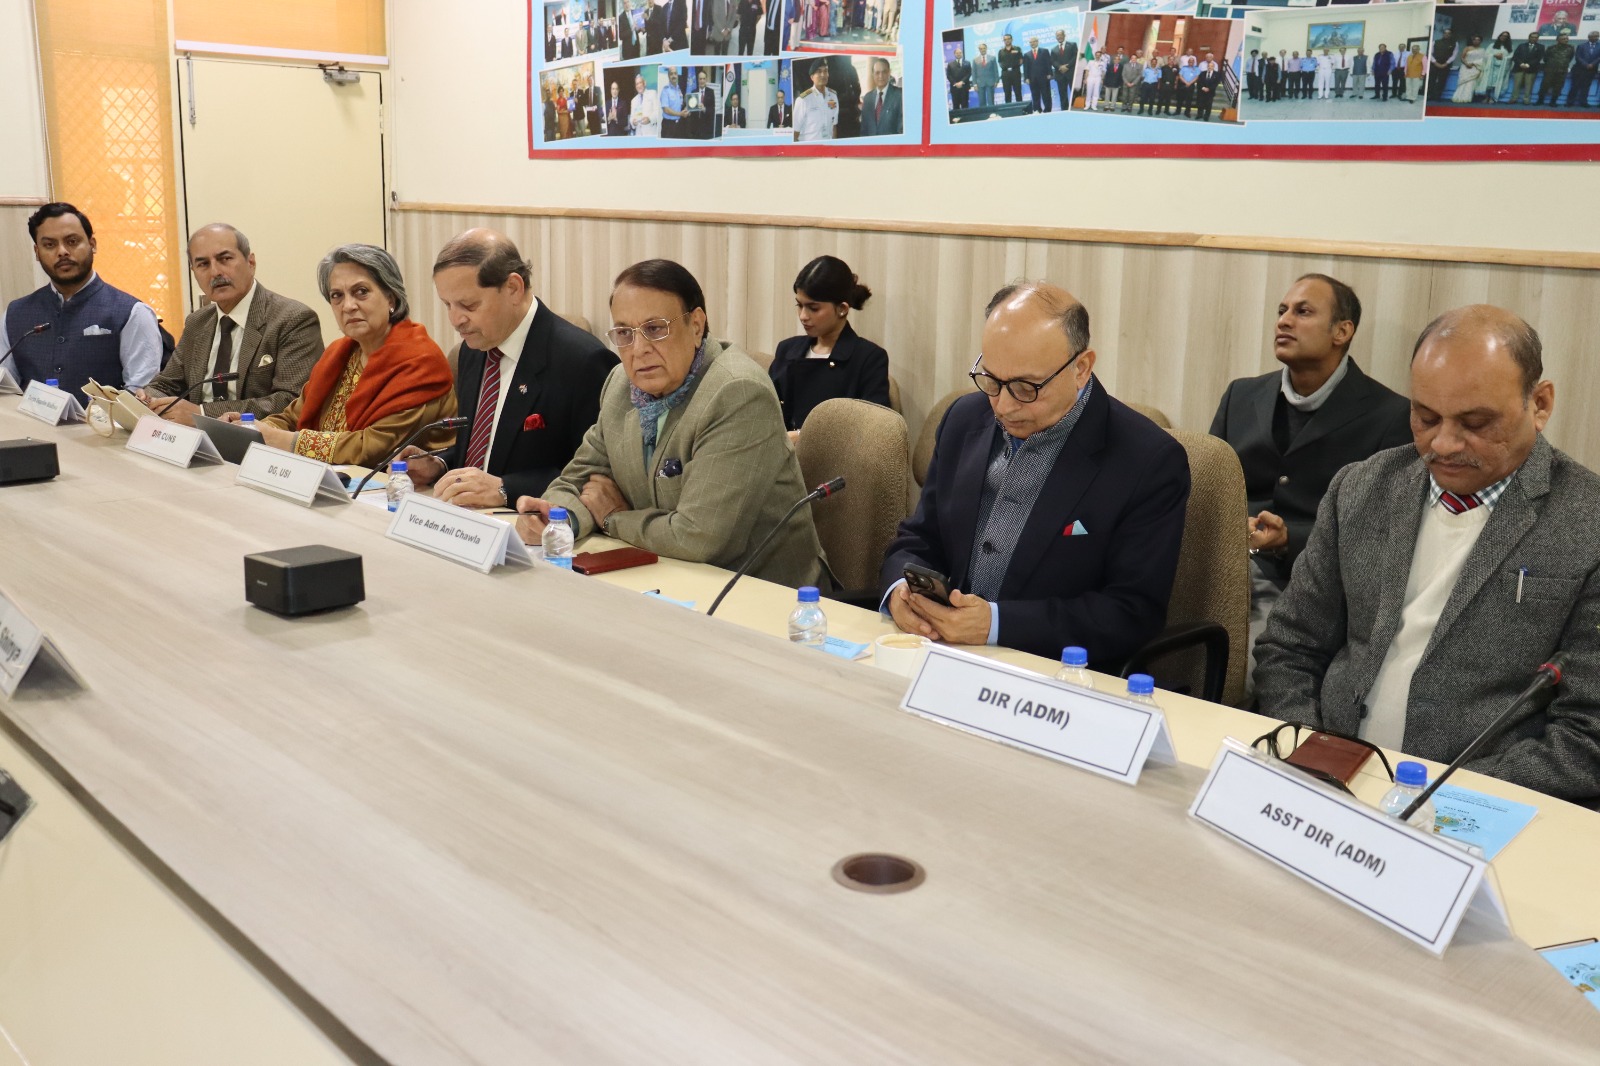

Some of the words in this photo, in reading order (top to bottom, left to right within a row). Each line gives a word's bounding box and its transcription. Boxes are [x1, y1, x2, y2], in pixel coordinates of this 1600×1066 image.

[151, 429, 162, 439] DIR
[268, 465, 279, 477] DG,
[279, 468, 292, 479] USI
[408, 513, 424, 526] Vice
[423, 519, 439, 531] Adm
[439, 524, 455, 536] Anil
[455, 530, 481, 545] Chawla
[977, 687, 1011, 709] DIR
[1013, 697, 1071, 731] (ADM)
[1260, 803, 1304, 832] ASST
[1304, 823, 1335, 849] DIR
[1334, 839, 1387, 878] (ADM)
